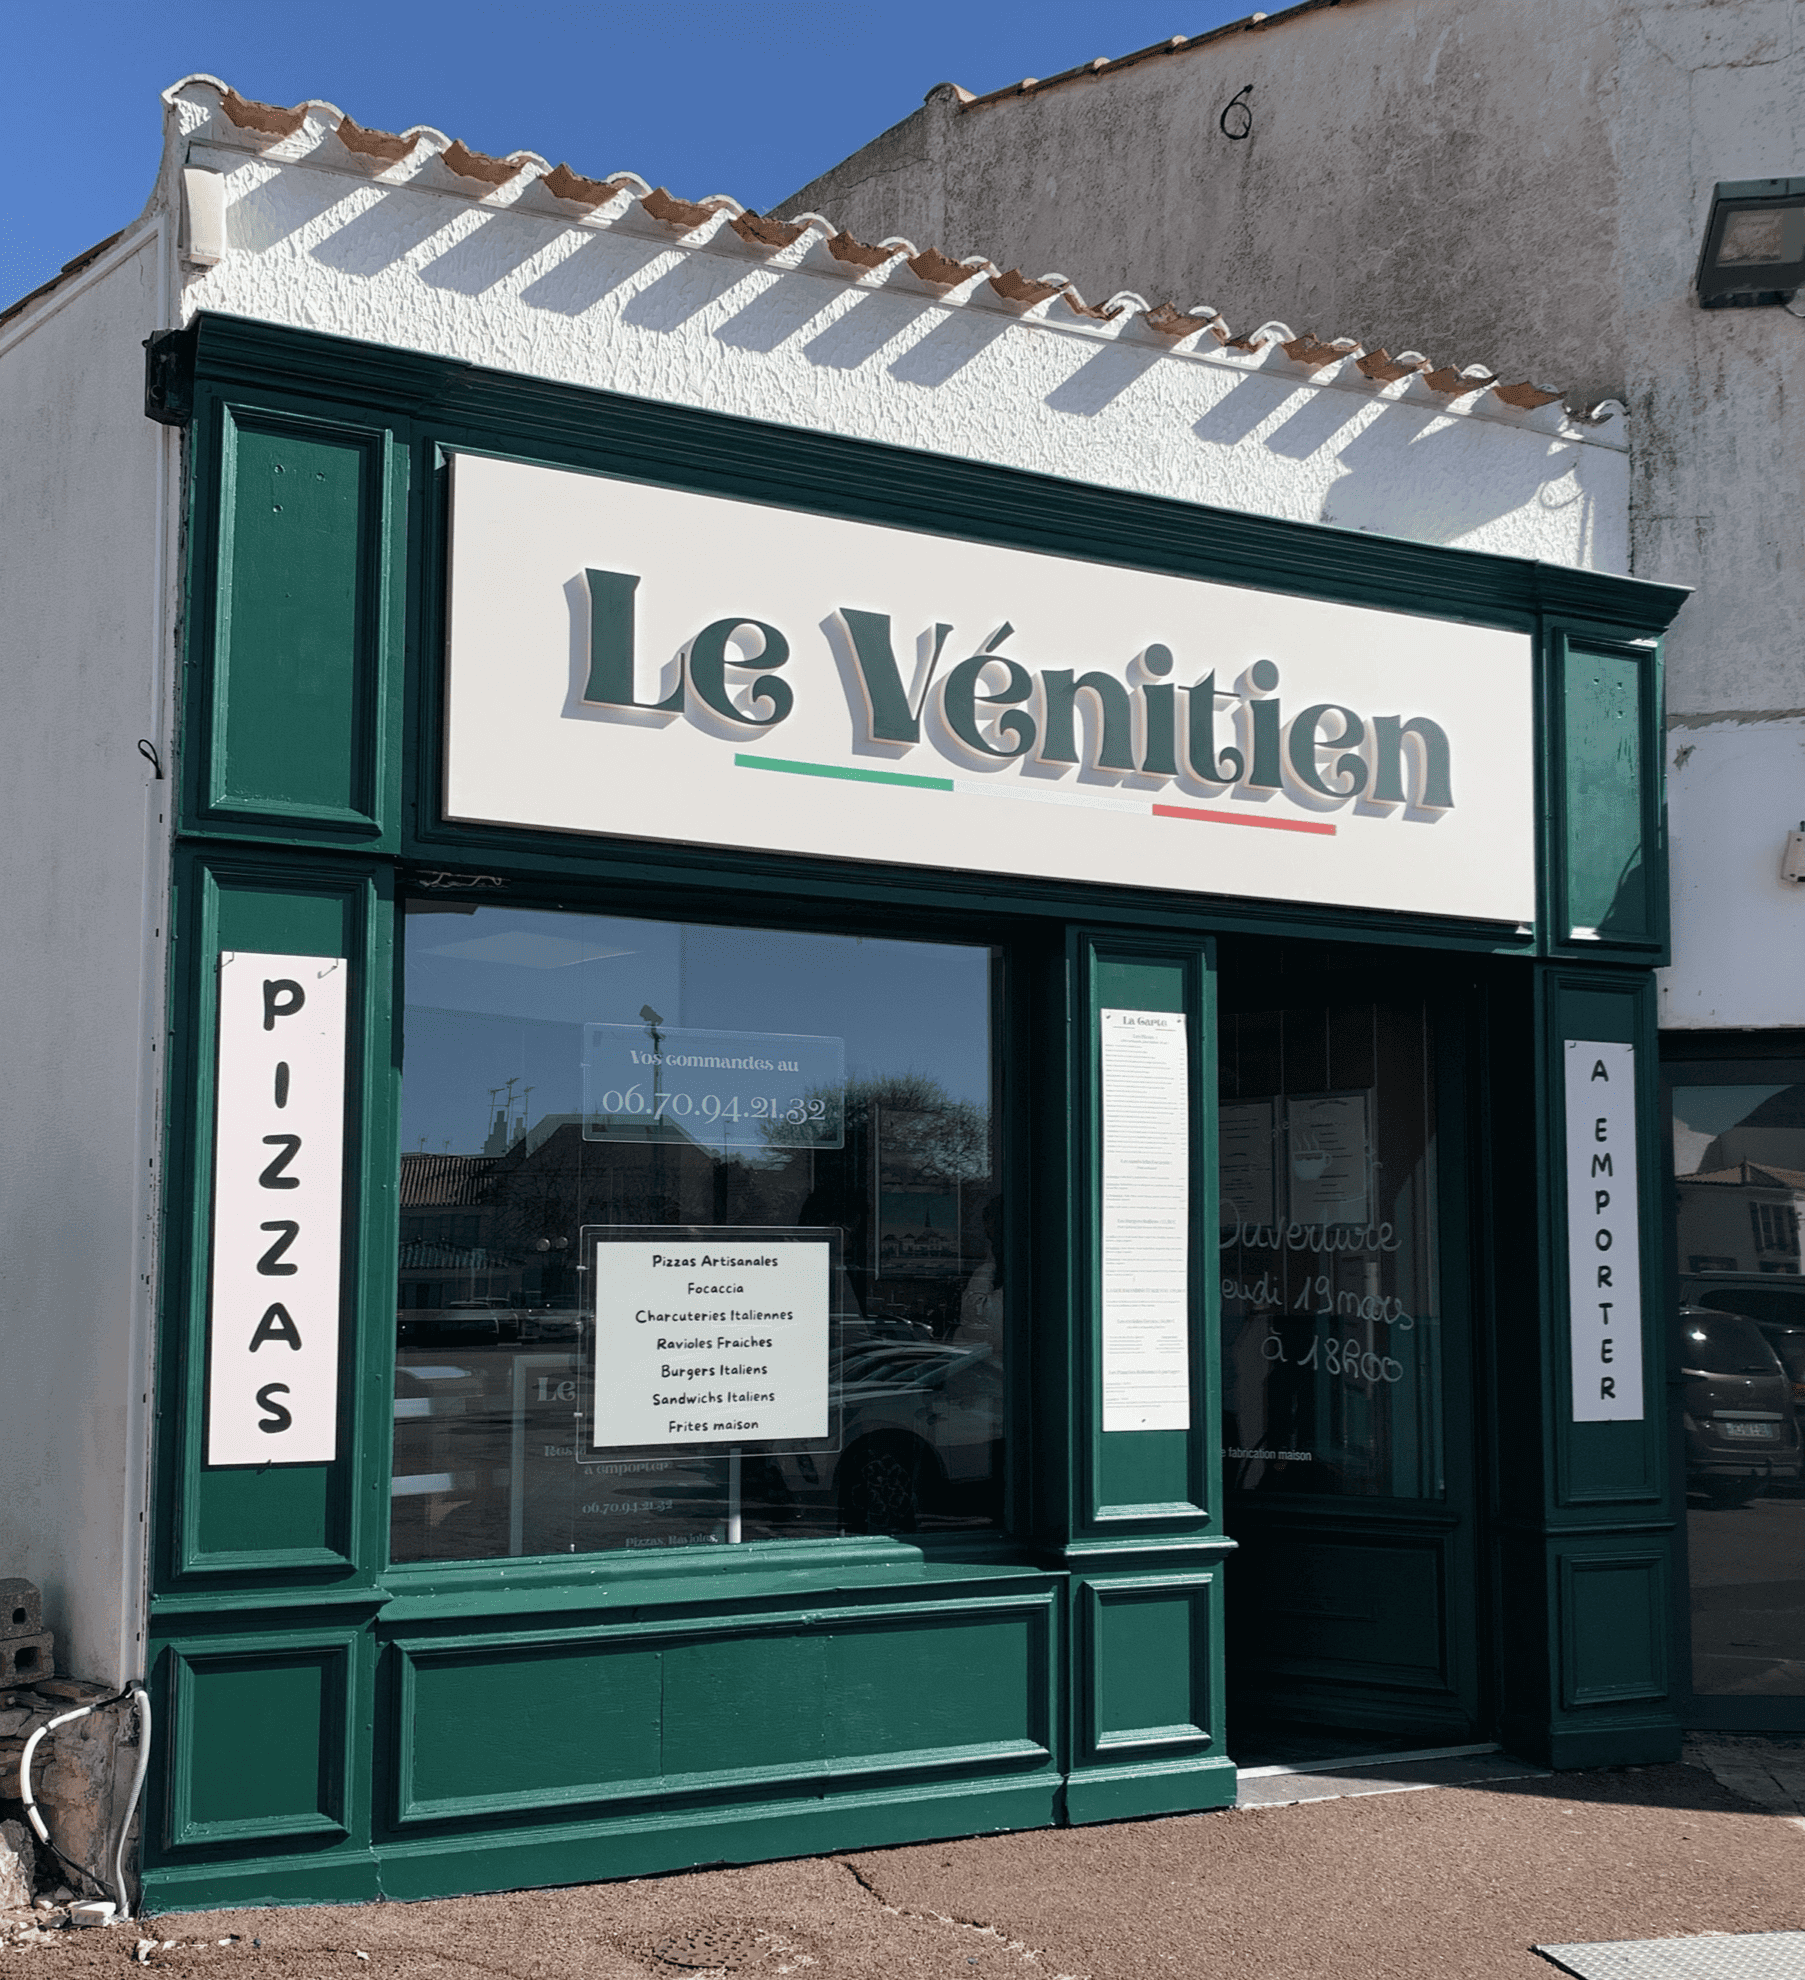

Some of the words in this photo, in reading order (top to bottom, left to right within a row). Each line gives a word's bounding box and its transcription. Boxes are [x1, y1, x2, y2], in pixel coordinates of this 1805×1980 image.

[560, 567, 795, 742] Le
[818, 612, 1456, 824] Vénitien
[629, 1050, 662, 1066] Vos
[665, 1053, 774, 1072] commandes
[777, 1060, 800, 1073] au
[1591, 1059, 1609, 1083] A
[602, 1083, 827, 1126] 06.70.94.21.32
[248, 978, 306, 1434] PIZZAS
[652, 1254, 697, 1268] Pizzas
[701, 1254, 779, 1268] Artisanales
[1591, 1117, 1617, 1400] EMPORTER
[687, 1282, 745, 1295] Focaccia
[1220, 1271, 1283, 1306] eudi
[1293, 1275, 1334, 1315] 19
[635, 1309, 727, 1324] Charcuteries
[730, 1309, 794, 1322] Italiennes
[656, 1337, 713, 1351] Ravioles
[717, 1336, 773, 1350] Fraiches
[1260, 1326, 1288, 1363] à
[660, 1364, 716, 1381] Burgers
[720, 1364, 768, 1377] Italiens
[537, 1376, 577, 1402] Le
[652, 1391, 723, 1406] Sandwichs
[727, 1391, 776, 1403] Italiens
[668, 1420, 709, 1433] Frites
[713, 1419, 760, 1432] maison
[1228, 1447, 1277, 1460] fabrication
[1277, 1449, 1313, 1461] maison
[596, 1461, 671, 1477] emporter
